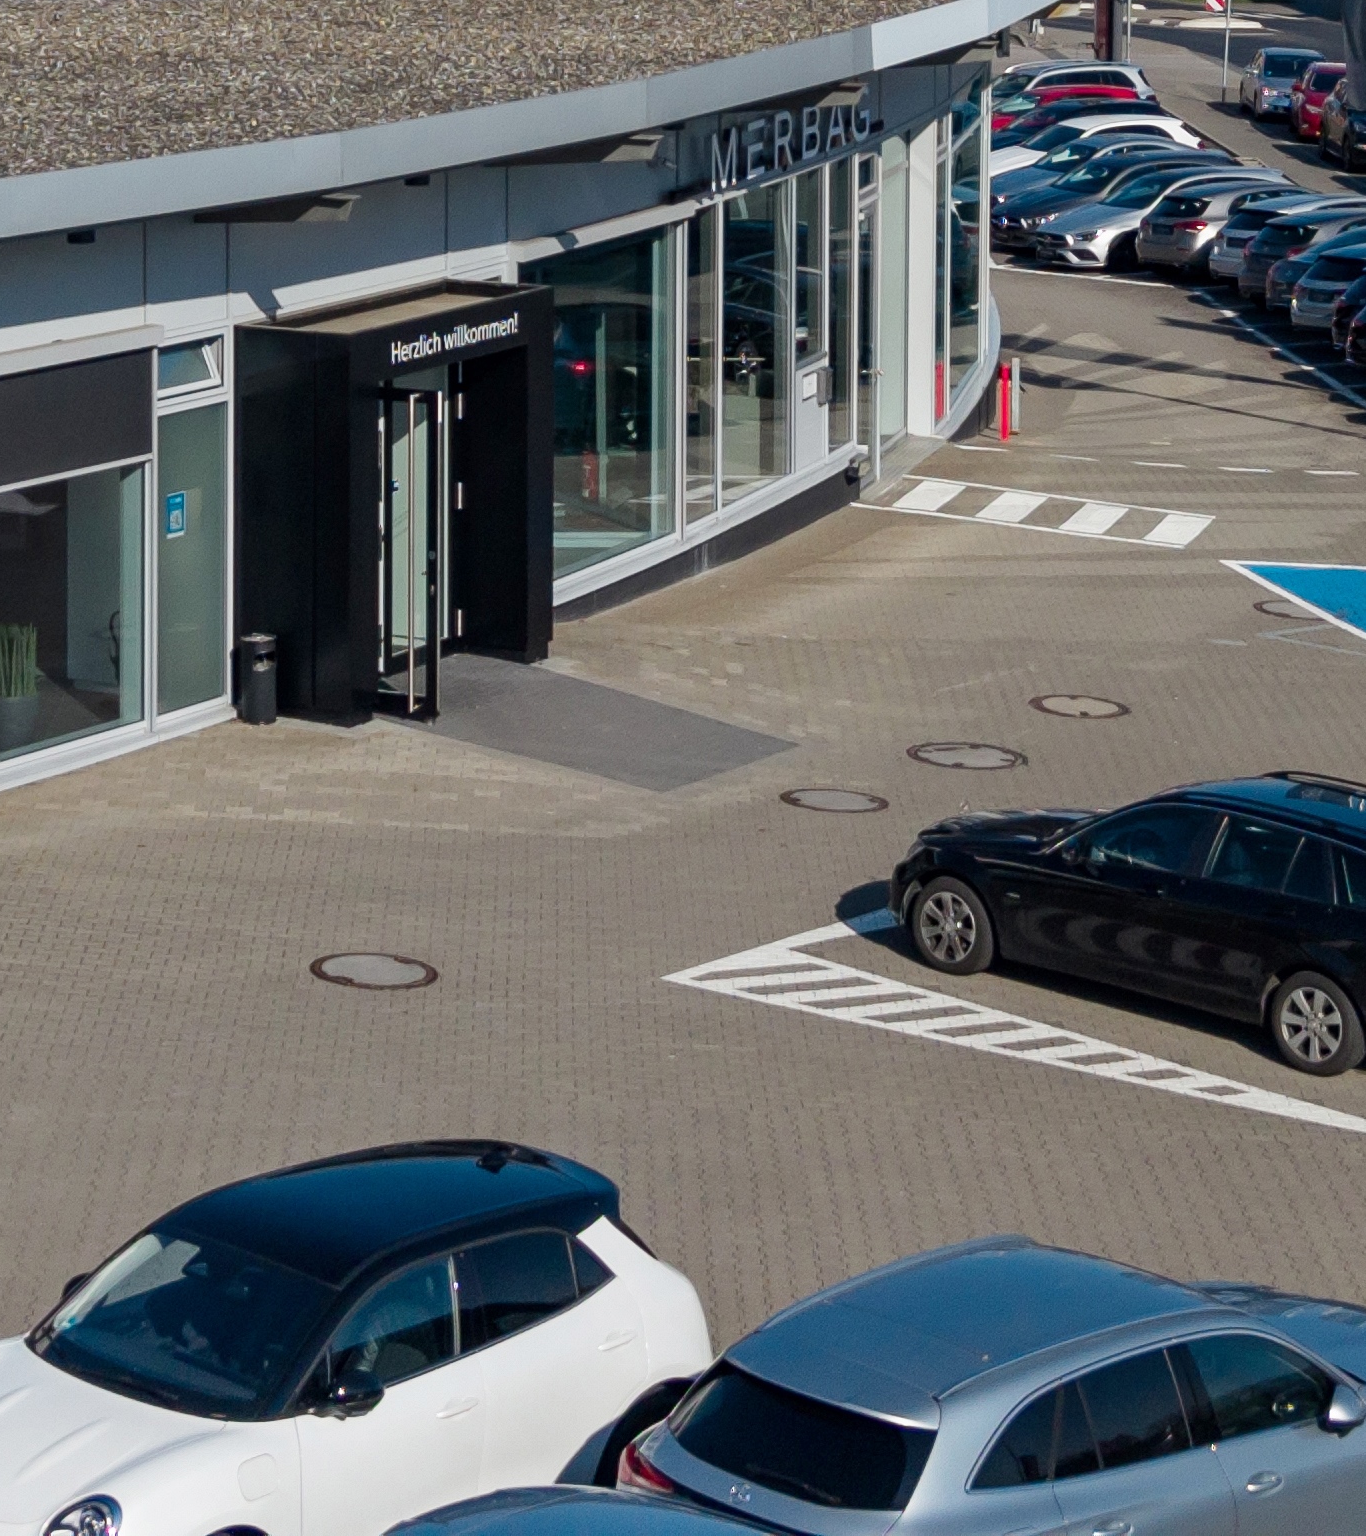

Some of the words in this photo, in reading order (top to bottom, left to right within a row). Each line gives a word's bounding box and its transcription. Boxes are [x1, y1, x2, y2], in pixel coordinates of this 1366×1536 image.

[711, 86, 871, 193] MERBAG
[391, 331, 441, 364] Herzlich
[443, 312, 518, 350] willkommen!
